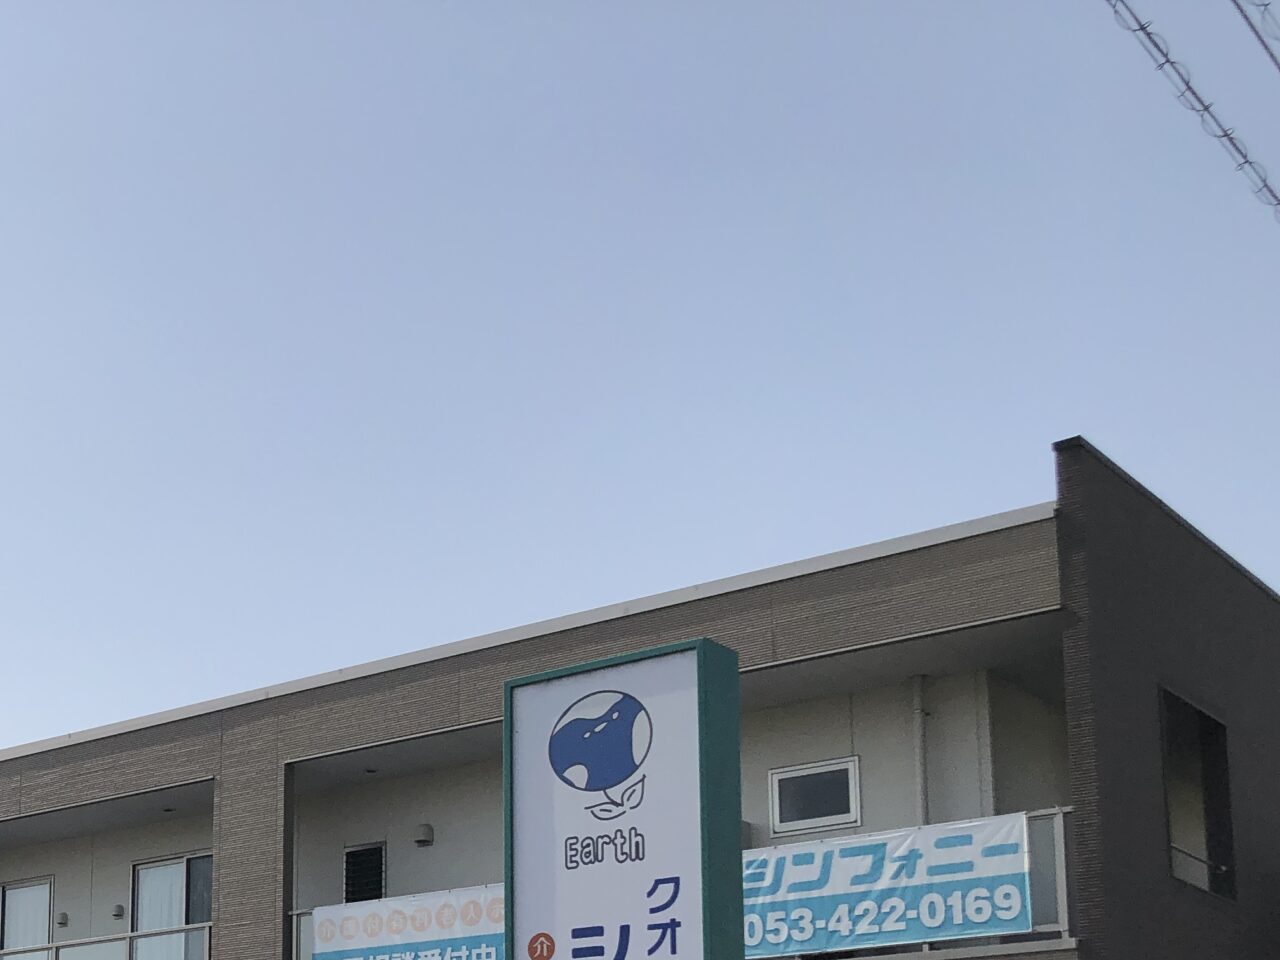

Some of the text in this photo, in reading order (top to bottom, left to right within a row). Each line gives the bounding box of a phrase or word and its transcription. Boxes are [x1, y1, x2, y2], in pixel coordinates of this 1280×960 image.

[564, 827, 646, 871] Earth
[743, 833, 1020, 899] シンフォニー
[744, 883, 1022, 947] 053-422-0169
